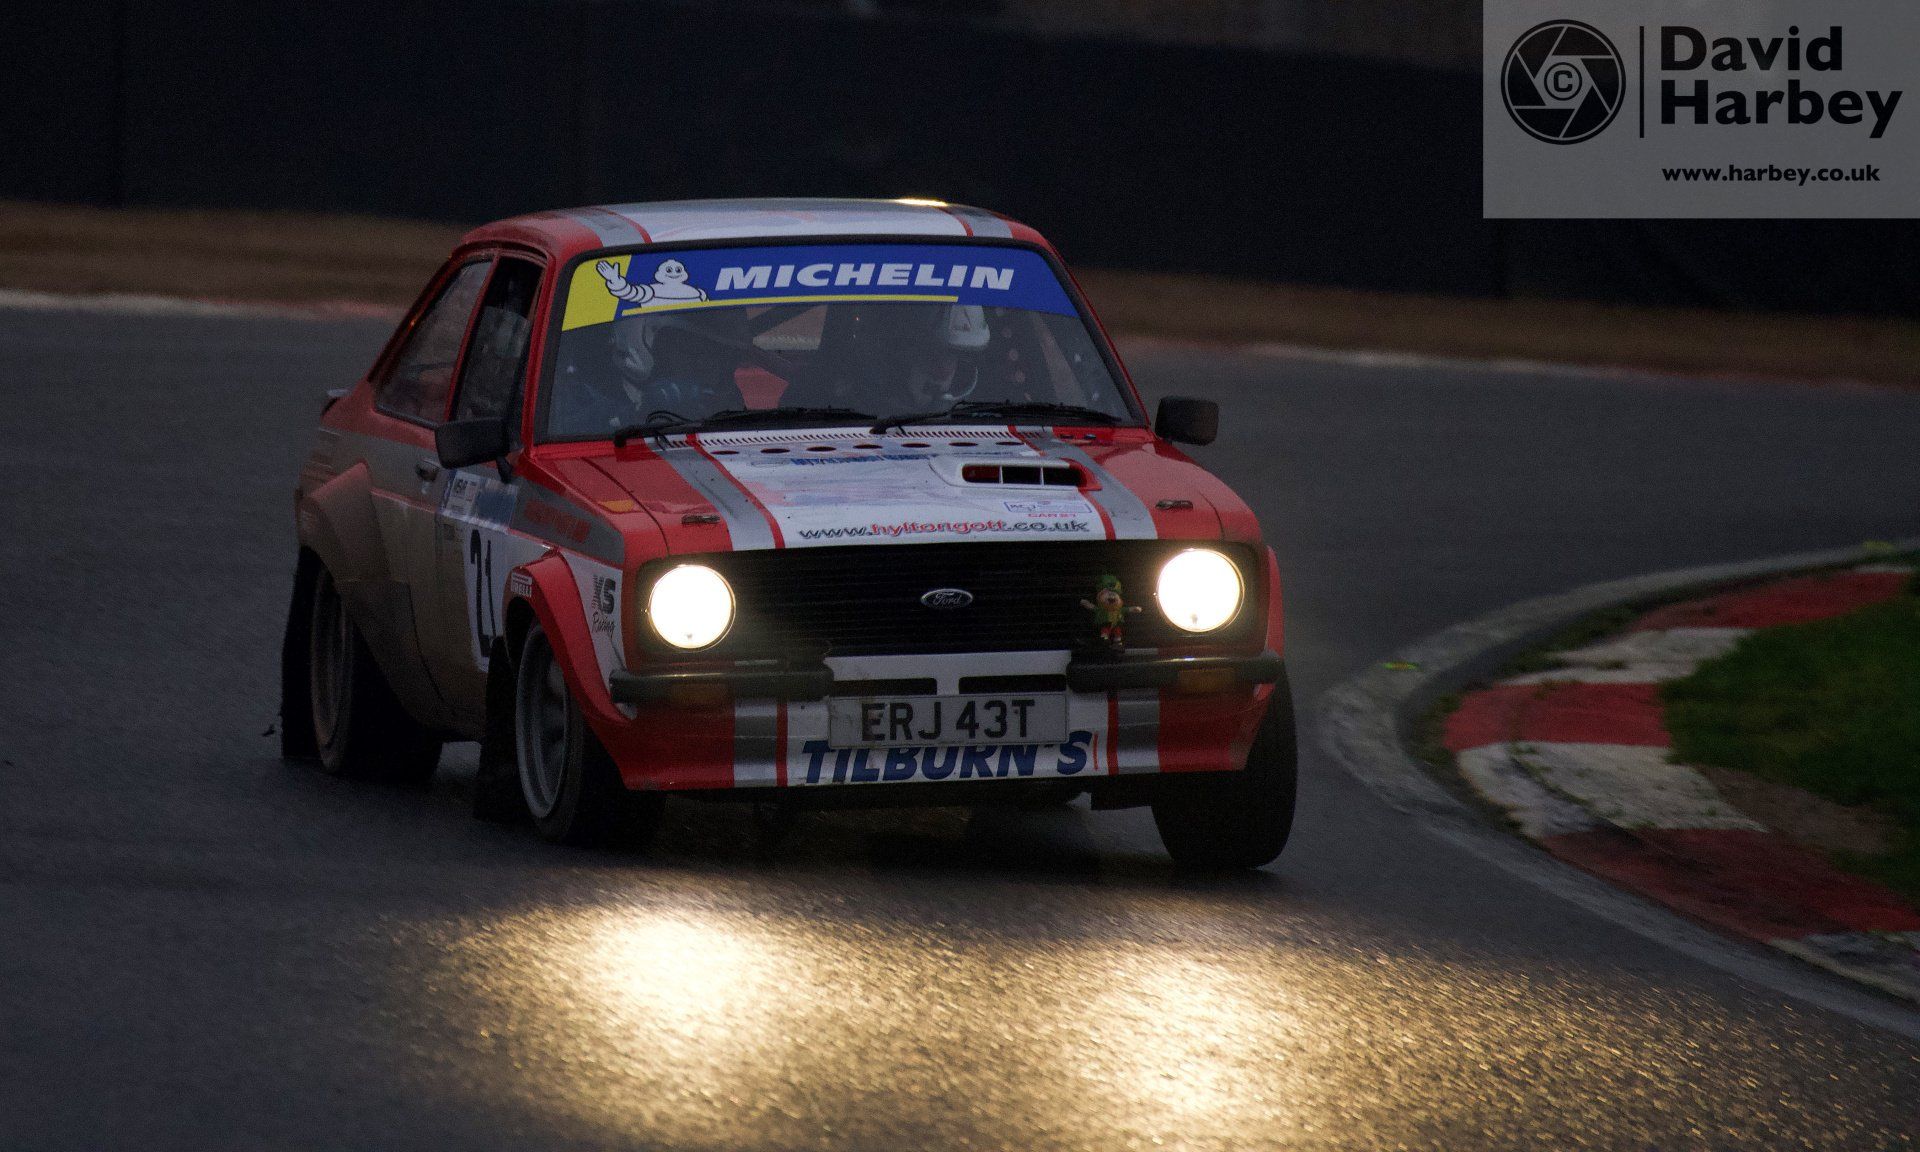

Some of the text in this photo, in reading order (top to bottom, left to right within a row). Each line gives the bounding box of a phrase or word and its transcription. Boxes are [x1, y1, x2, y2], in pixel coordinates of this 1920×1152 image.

[714, 263, 1015, 292] MICHELIN
[798, 520, 1090, 540] www.hyltongott.co.uk
[932, 592, 962, 607] Ford
[861, 699, 1036, 742] ERJ 43T
